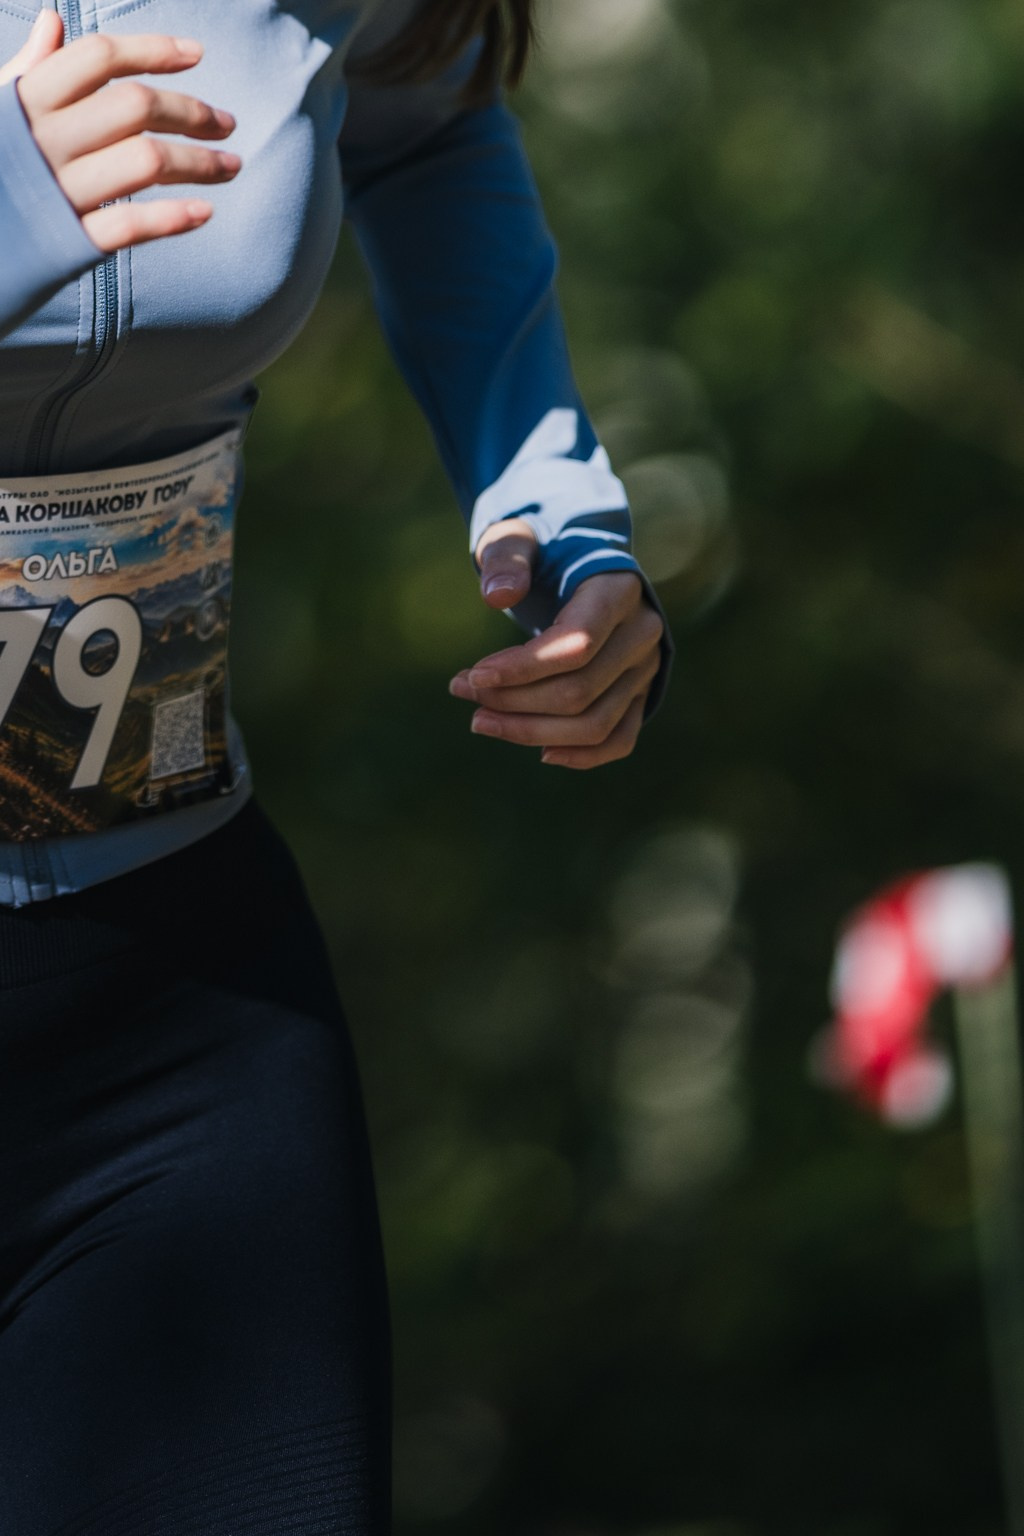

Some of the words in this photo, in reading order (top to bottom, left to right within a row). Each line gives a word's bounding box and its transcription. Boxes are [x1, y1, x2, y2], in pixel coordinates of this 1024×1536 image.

[16, 490, 148, 523] КОРШАКОВУ
[30, 490, 50, 498] ОАО
[21, 546, 118, 582] ОЛЬГА
